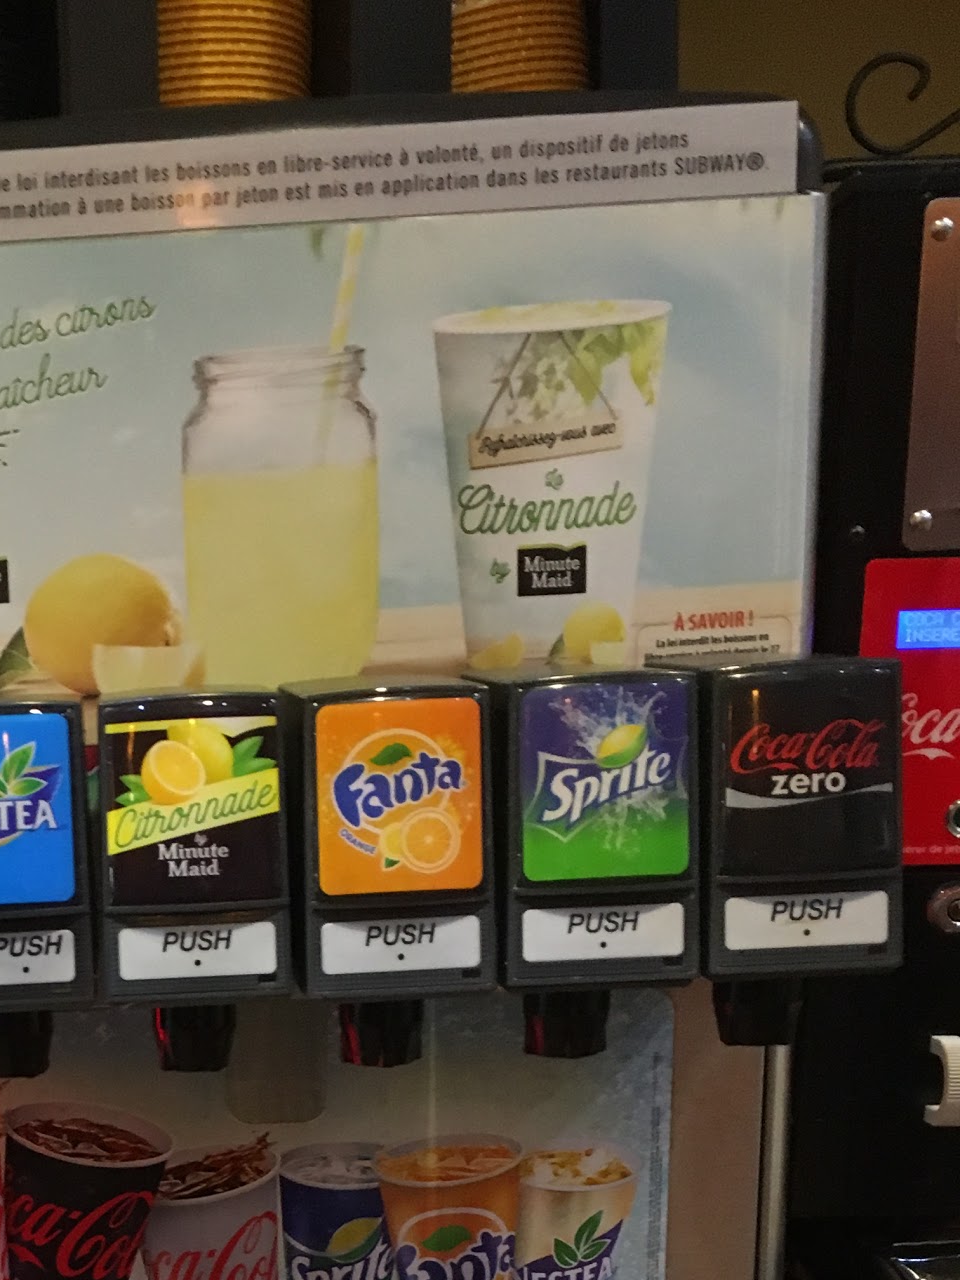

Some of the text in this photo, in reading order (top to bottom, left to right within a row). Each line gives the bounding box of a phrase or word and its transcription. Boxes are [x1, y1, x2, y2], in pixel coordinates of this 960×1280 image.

[17, 173, 38, 191] loi
[44, 166, 138, 189] interdisant
[145, 165, 170, 183] les
[176, 159, 251, 180] boissons
[257, 158, 277, 175] en
[284, 150, 393, 173] libre-service
[399, 147, 410, 166] à
[416, 142, 485, 165] volonté,
[491, 144, 512, 160] un
[519, 133, 604, 160] dispositif
[609, 133, 629, 152] de
[635, 132, 689, 154] jetons
[77, 197, 87, 215] à
[94, 197, 125, 213] une
[130, 192, 194, 211] boisson
[201, 189, 230, 209] par
[235, 185, 278, 208] jeton
[284, 182, 311, 201] est
[318, 181, 348, 198] mis
[354, 180, 374, 196] en
[381, 172, 479, 197] application
[486, 168, 528, 188] dans
[534, 166, 559, 184] les
[565, 159, 668, 183] restaurants
[0, 308, 48, 350] des
[56, 294, 157, 338] citrons
[457, 480, 637, 535] Citronnade
[524, 556, 581, 573] Minute
[531, 573, 574, 589] Maid
[688, 611, 745, 631] SAVOIR
[730, 719, 886, 775] Coca-Cola
[333, 750, 462, 828] Fanta
[542, 747, 672, 823] Sprite
[771, 771, 846, 796] zero
[114, 782, 277, 850] Citronnade
[157, 843, 229, 861] Minute
[339, 828, 377, 855] ORANGE
[167, 859, 220, 878] Maid
[567, 911, 639, 934] PUSH
[770, 899, 844, 923] PUSH
[162, 929, 232, 953] PUSH
[365, 923, 435, 947] PUSH
